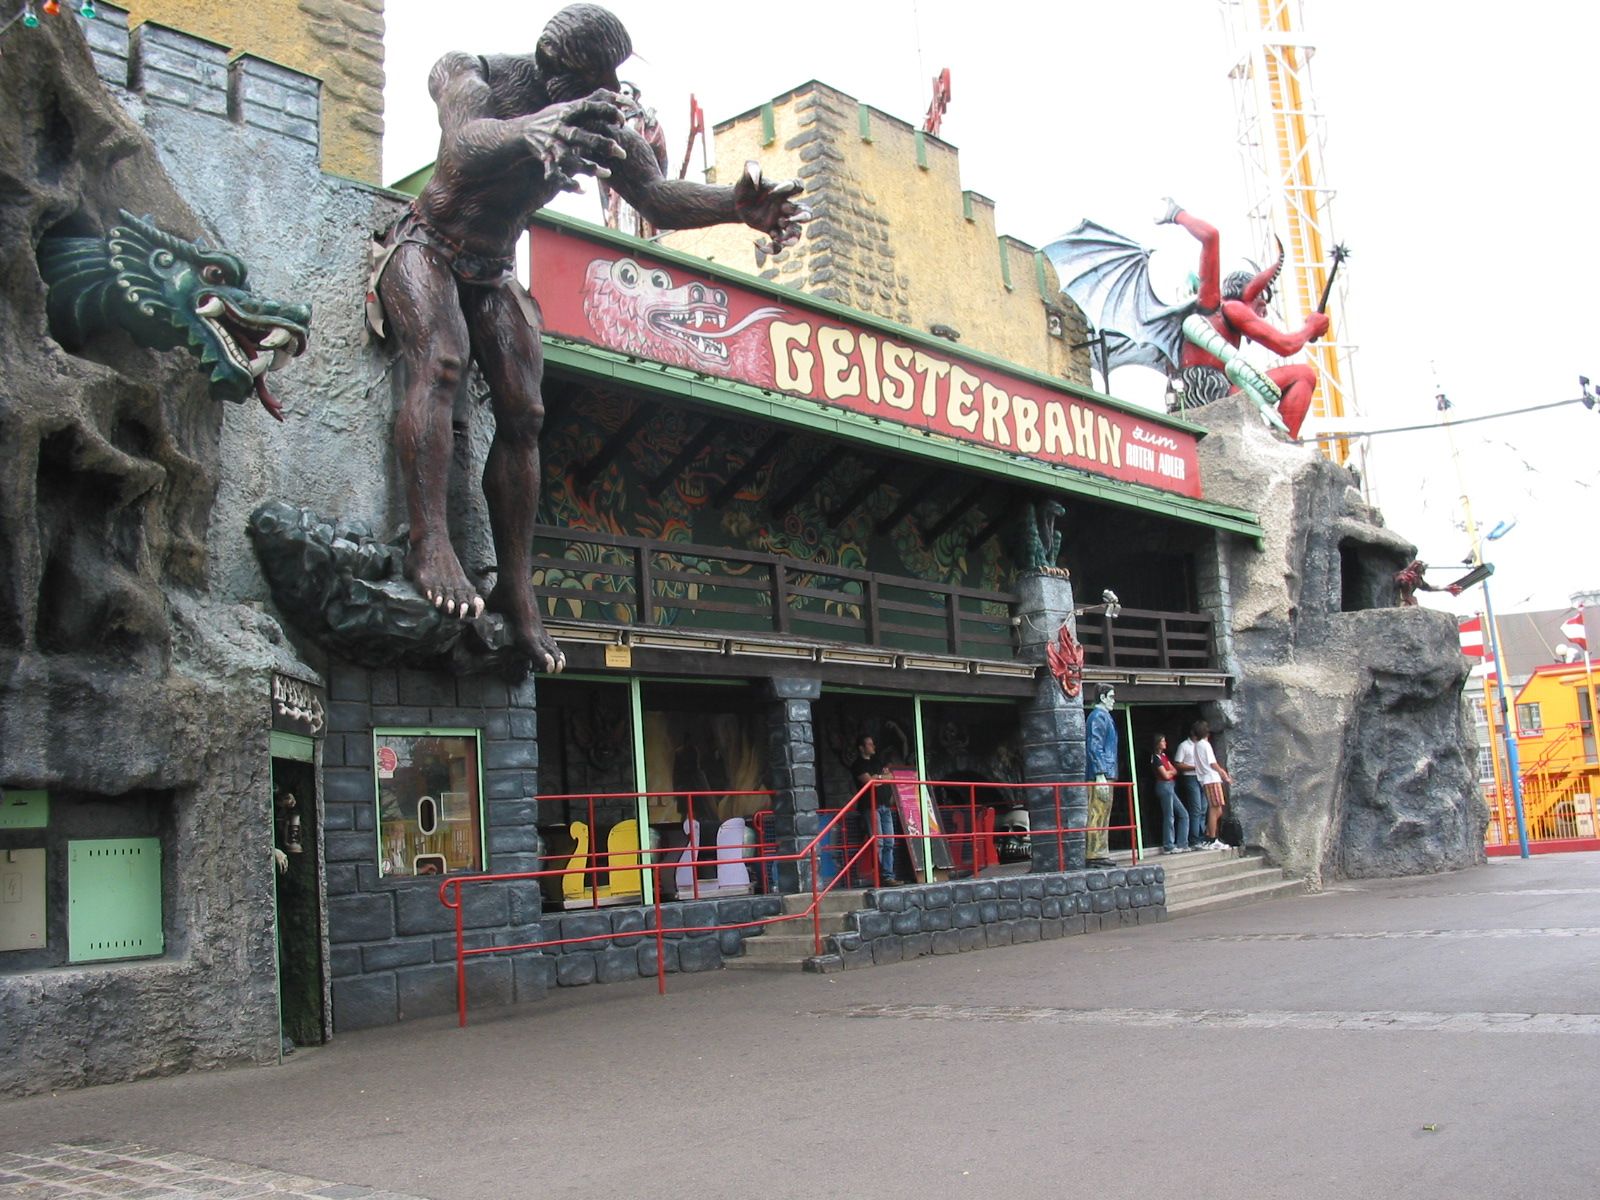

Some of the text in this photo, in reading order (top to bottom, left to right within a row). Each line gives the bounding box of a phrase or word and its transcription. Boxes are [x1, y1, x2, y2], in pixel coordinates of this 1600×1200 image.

[769, 320, 1122, 469] GEISTERBAHN
[1132, 425, 1178, 450] zum
[1125, 442, 1185, 481] ROTEN ADLER
